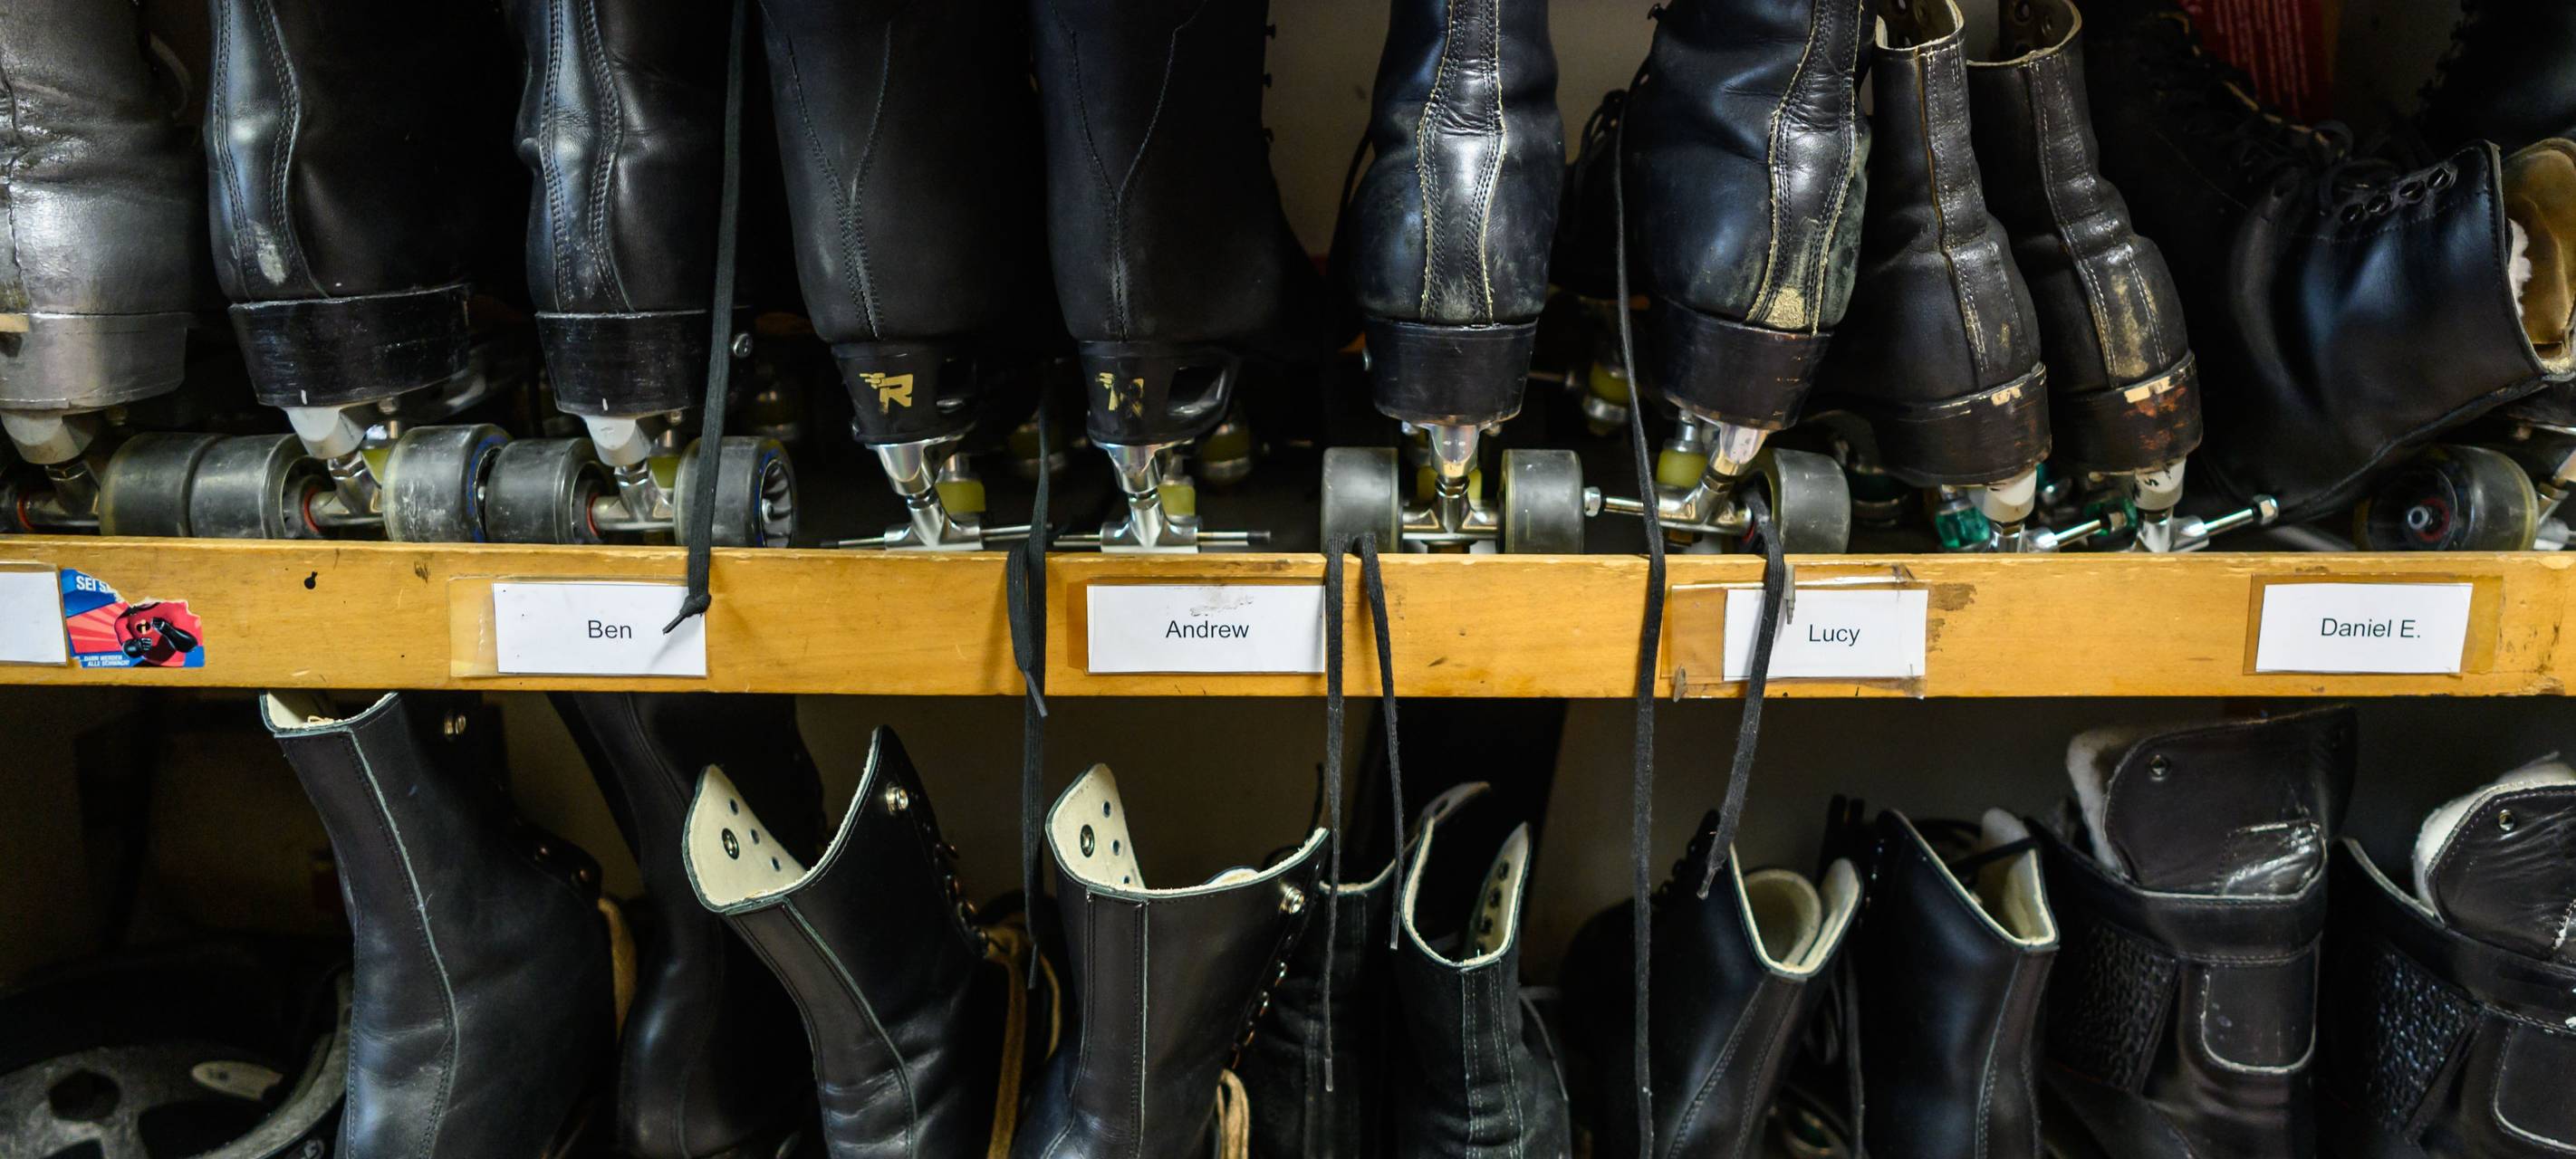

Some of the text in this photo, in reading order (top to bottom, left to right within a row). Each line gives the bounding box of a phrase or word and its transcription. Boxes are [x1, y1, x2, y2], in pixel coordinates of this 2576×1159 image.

[76, 575, 96, 591] SEI
[588, 619, 632, 638] Ben
[1165, 619, 1250, 638] Andrew
[1809, 624, 1860, 647] Lucy
[2321, 618, 2421, 638] Daniel E.
